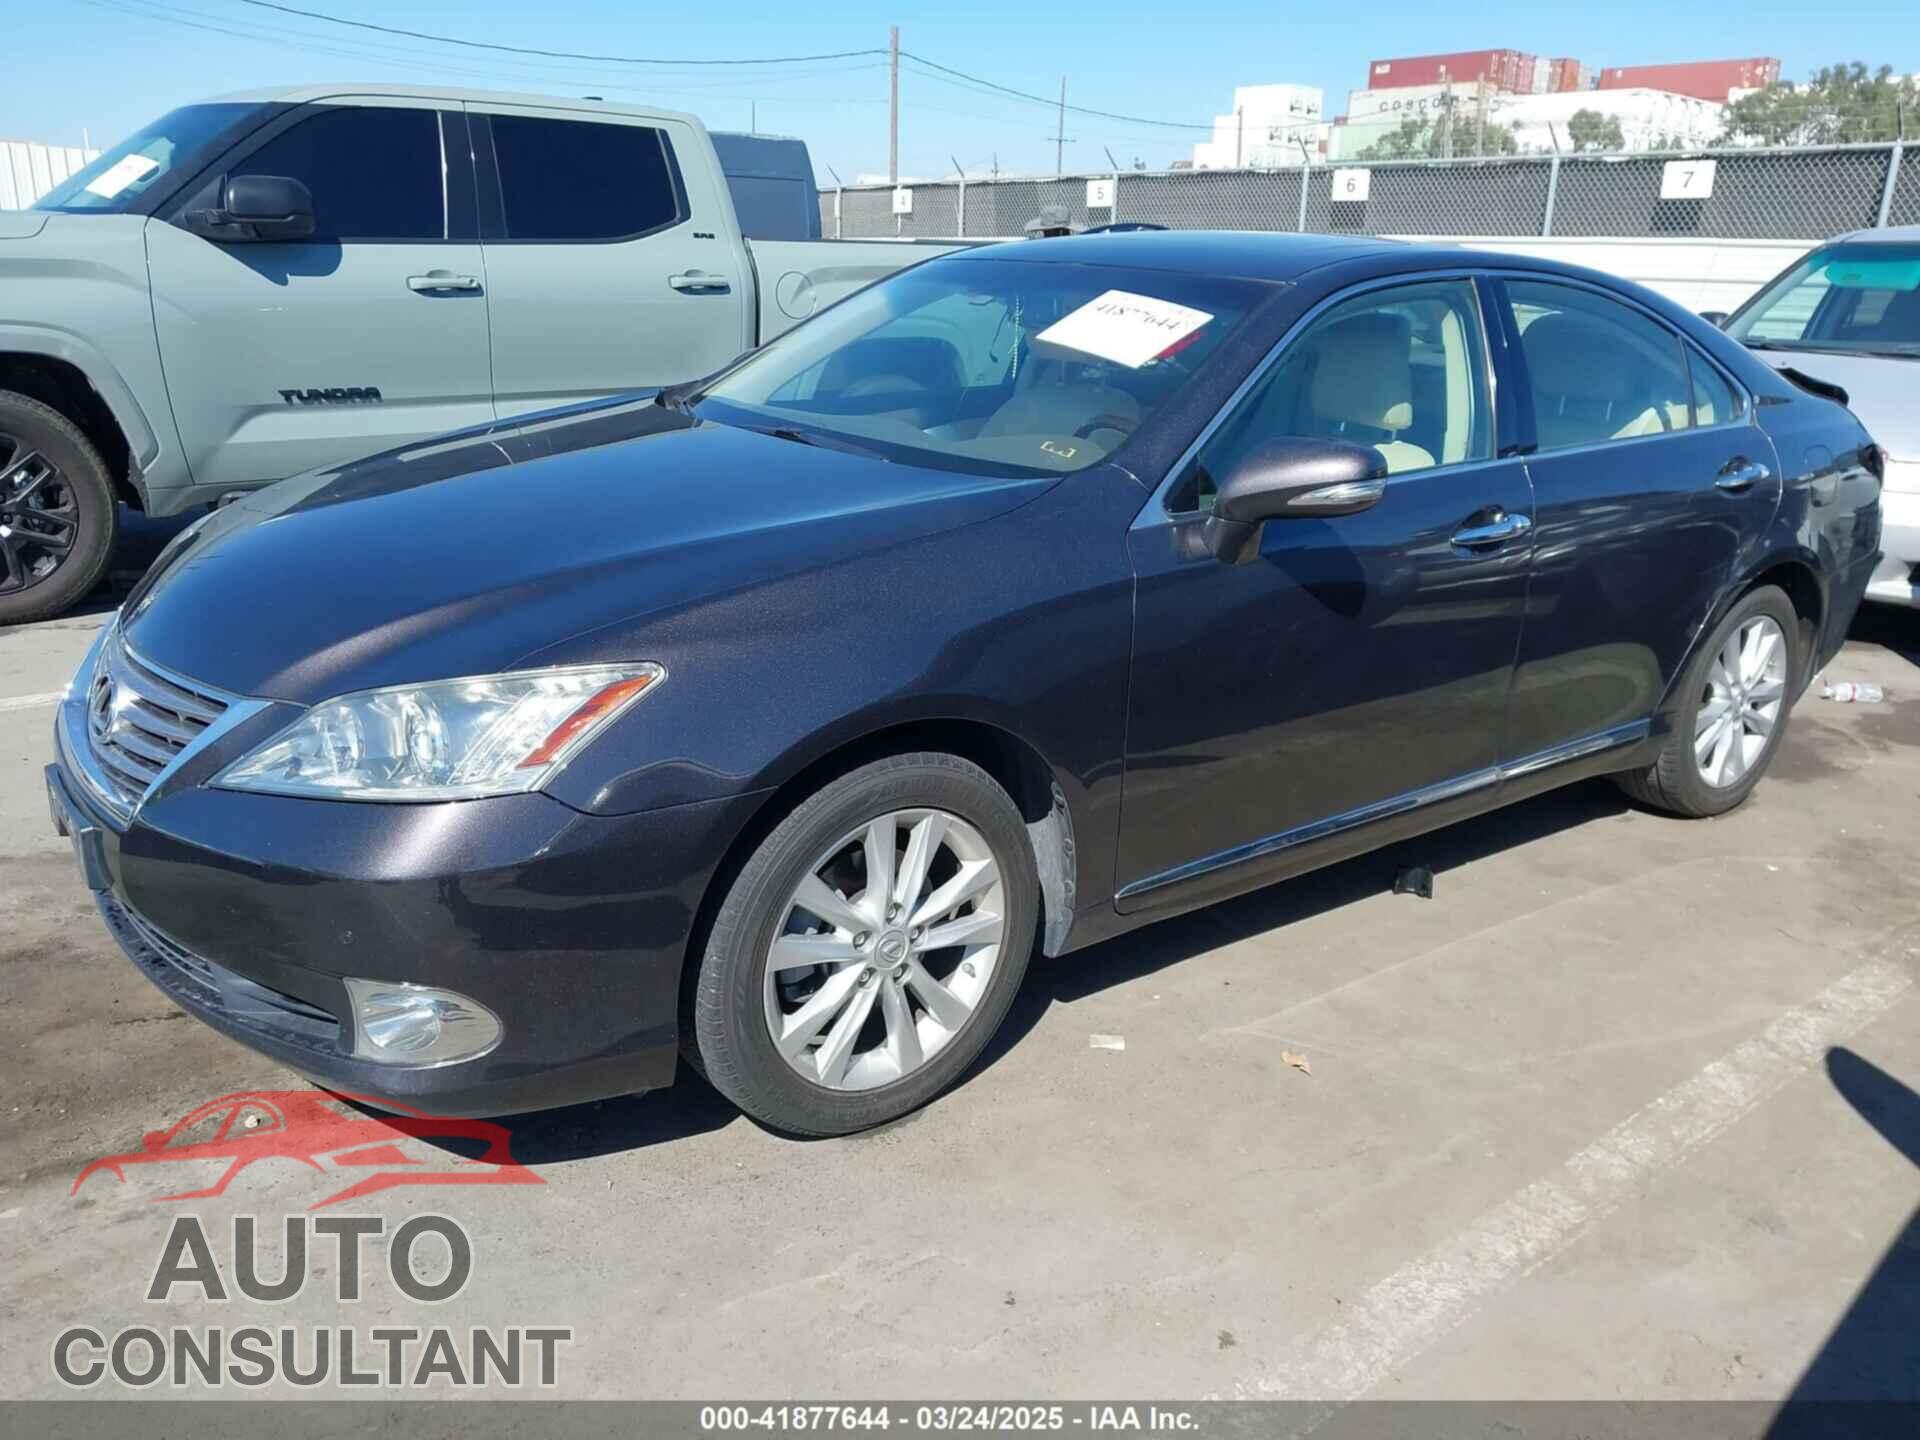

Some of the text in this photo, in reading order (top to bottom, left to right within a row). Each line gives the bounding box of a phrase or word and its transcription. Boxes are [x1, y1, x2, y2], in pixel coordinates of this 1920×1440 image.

[1346, 177, 1357, 193] 6
[1681, 170, 1695, 189] 7
[1096, 186, 1105, 201] 5
[277, 386, 384, 406] TUNDRA
